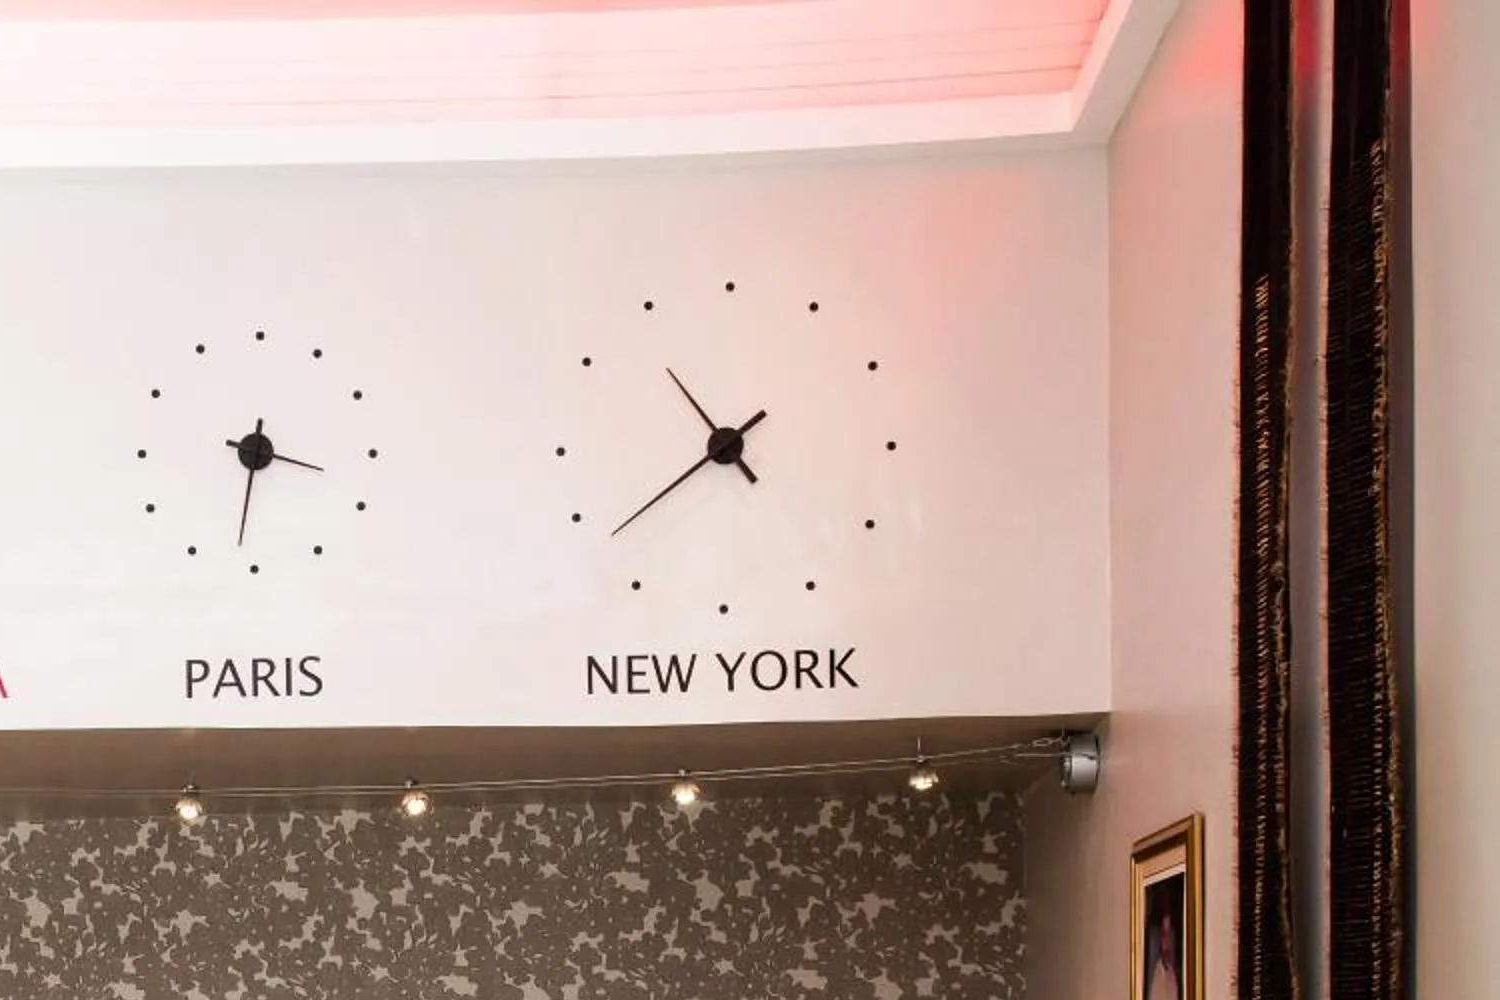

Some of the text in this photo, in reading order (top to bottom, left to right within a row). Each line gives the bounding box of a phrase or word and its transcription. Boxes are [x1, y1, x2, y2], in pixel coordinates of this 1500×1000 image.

[186, 656, 323, 699] PARIS
[588, 647, 860, 695] NEW YORK
